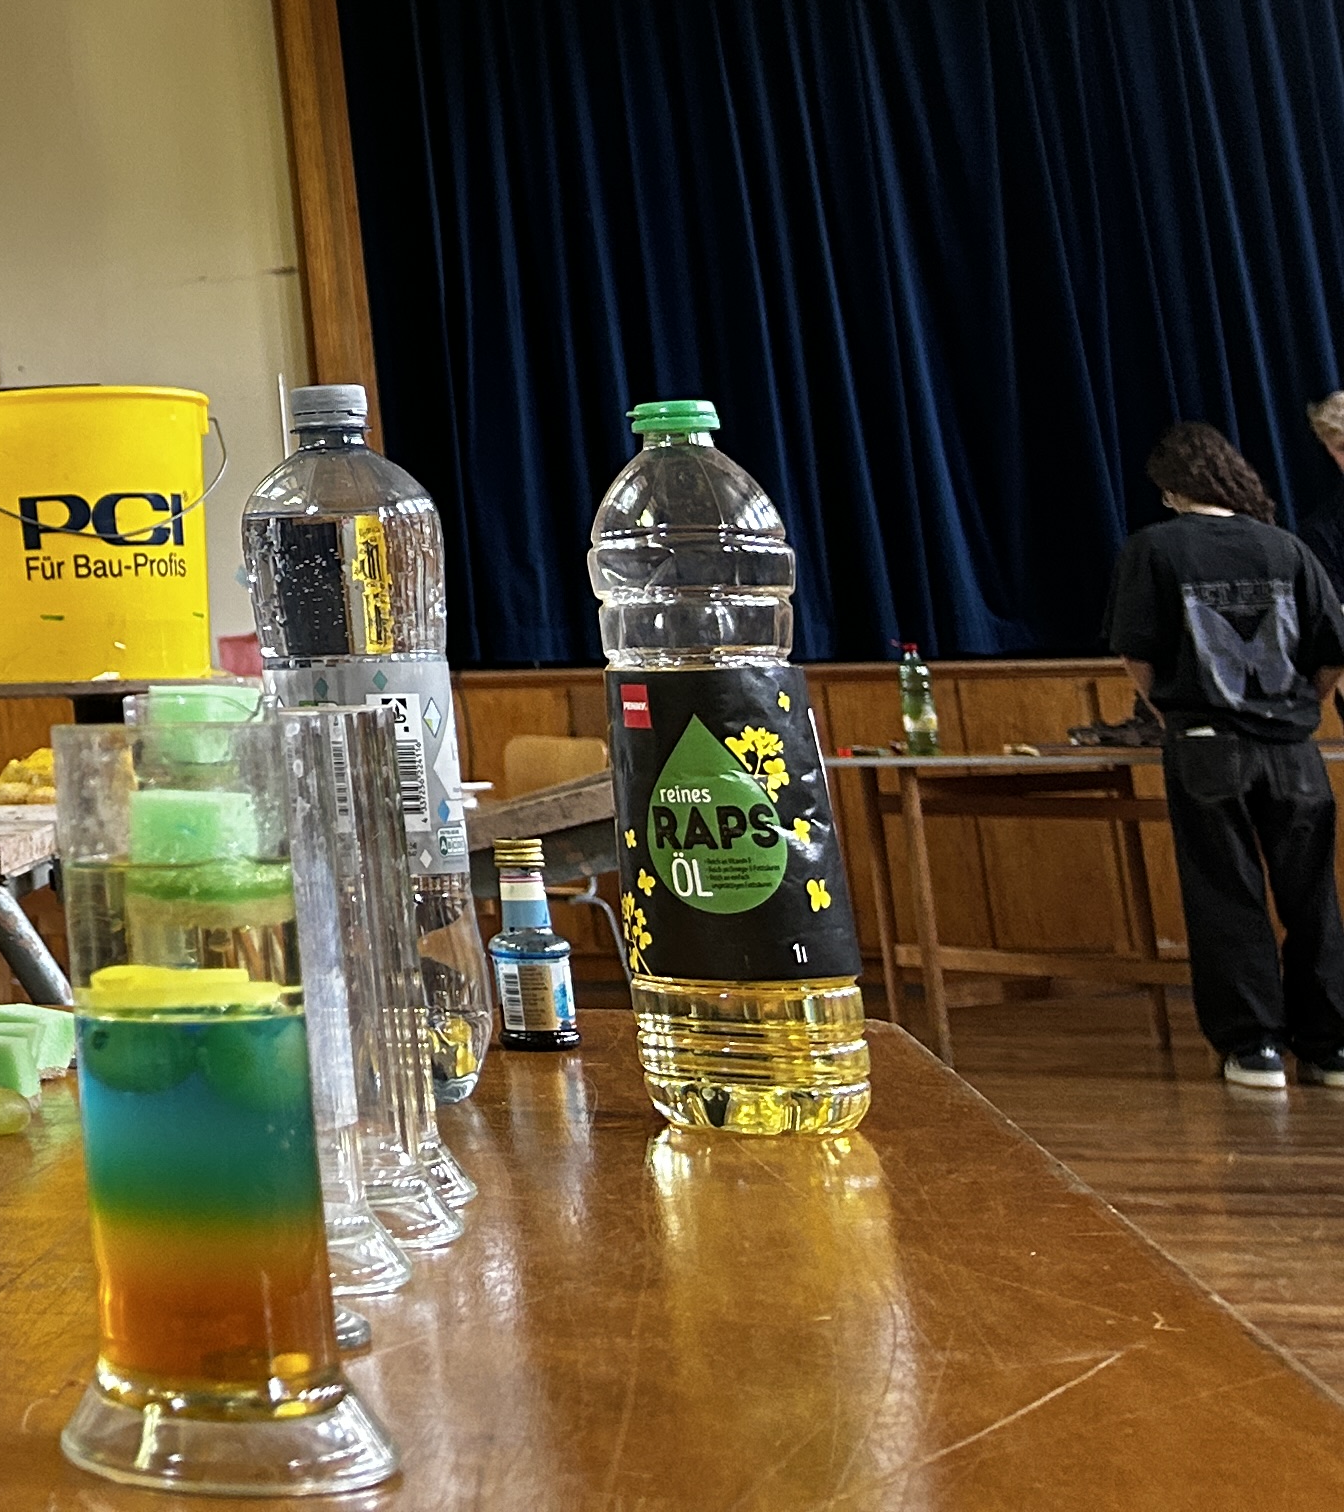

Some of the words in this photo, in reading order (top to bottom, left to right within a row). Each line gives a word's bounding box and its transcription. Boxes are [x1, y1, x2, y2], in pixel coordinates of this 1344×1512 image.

[19, 492, 184, 550] PCI
[25, 556, 65, 581] Für
[73, 552, 187, 579] Bau-Profis
[660, 785, 712, 803] reines
[652, 803, 780, 850] RAPS
[671, 852, 714, 897] ÖL
